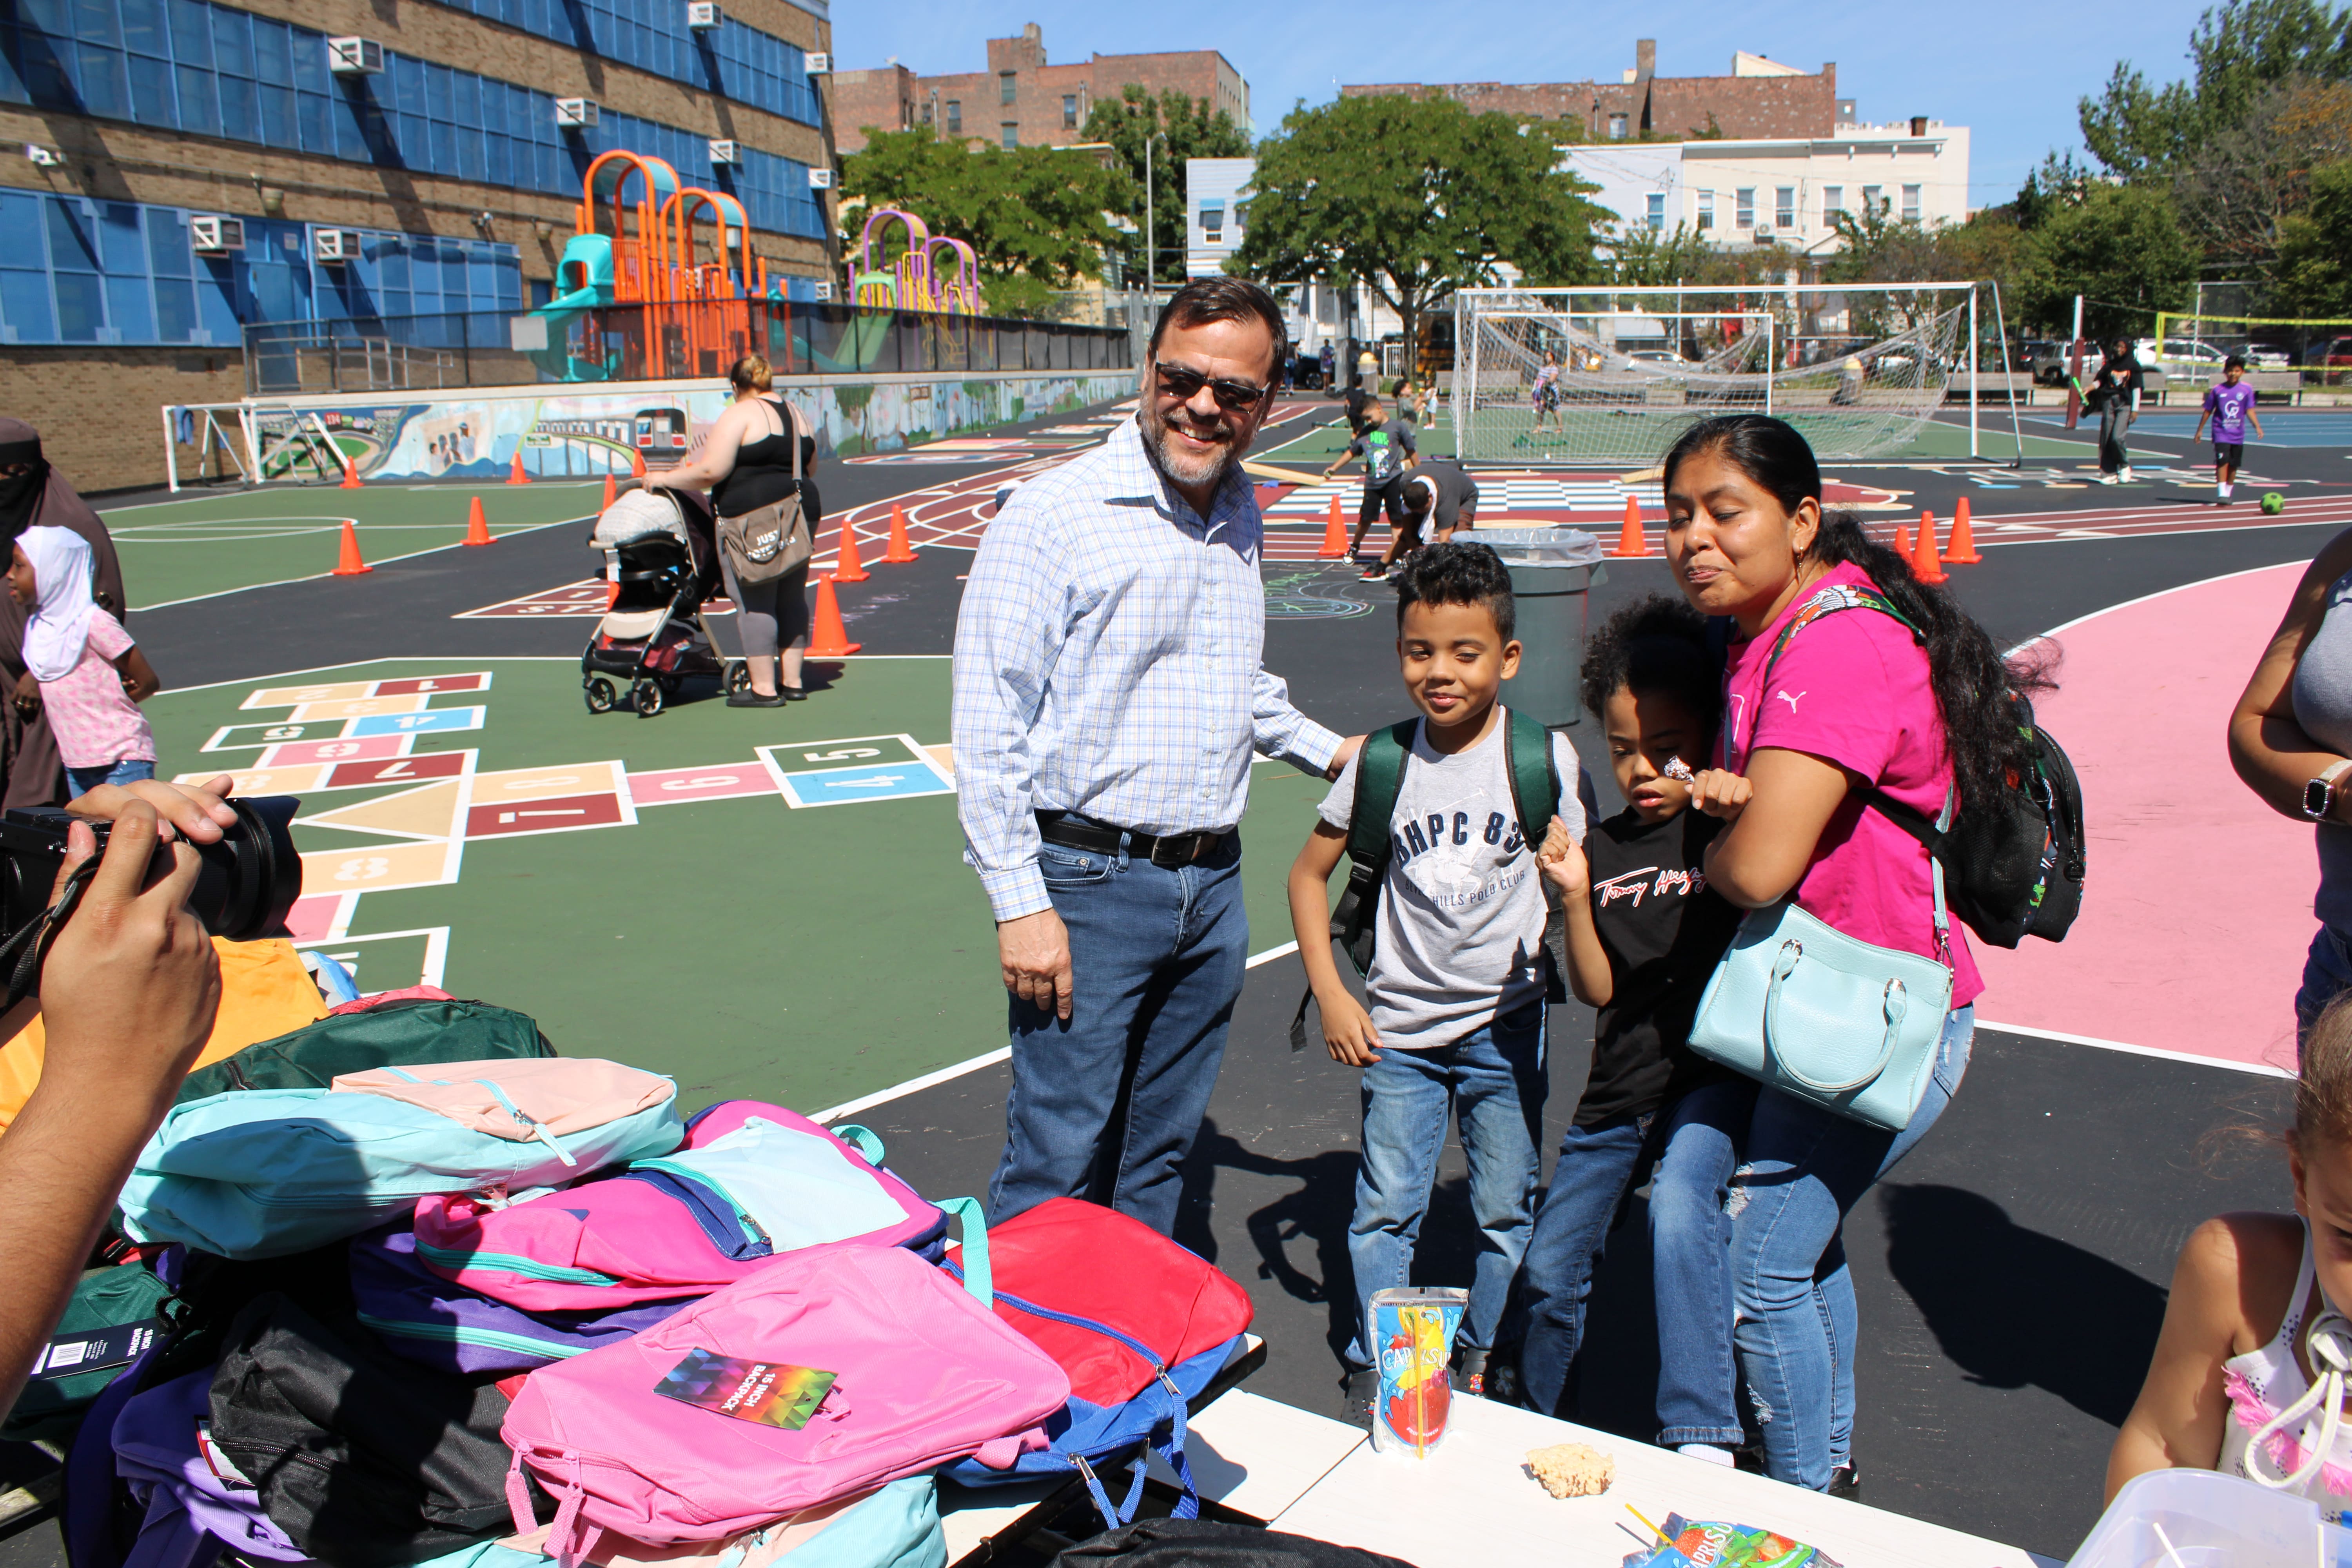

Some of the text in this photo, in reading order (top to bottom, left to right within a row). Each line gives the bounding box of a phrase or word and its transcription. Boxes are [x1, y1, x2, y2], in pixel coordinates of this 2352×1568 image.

[263, 715, 437, 740] 5 4
[804, 748, 881, 762] 5
[824, 775, 906, 788] 4
[1394, 812, 1468, 869] BHPC
[1432, 894, 1465, 907] HILLS
[1470, 884, 1495, 903] POLO
[1500, 870, 1524, 891] CLUB
[1594, 866, 1659, 907] Tommy
[127, 1327, 143, 1357] BACKPACK
[140, 1336, 152, 1350] INCH
[1382, 1347, 1451, 1370] CAPISU
[720, 1364, 767, 1411] BACKPACK
[743, 1373, 776, 1407] 15 INCH
[1406, 1426, 1439, 1437] FRUI PUNCH
